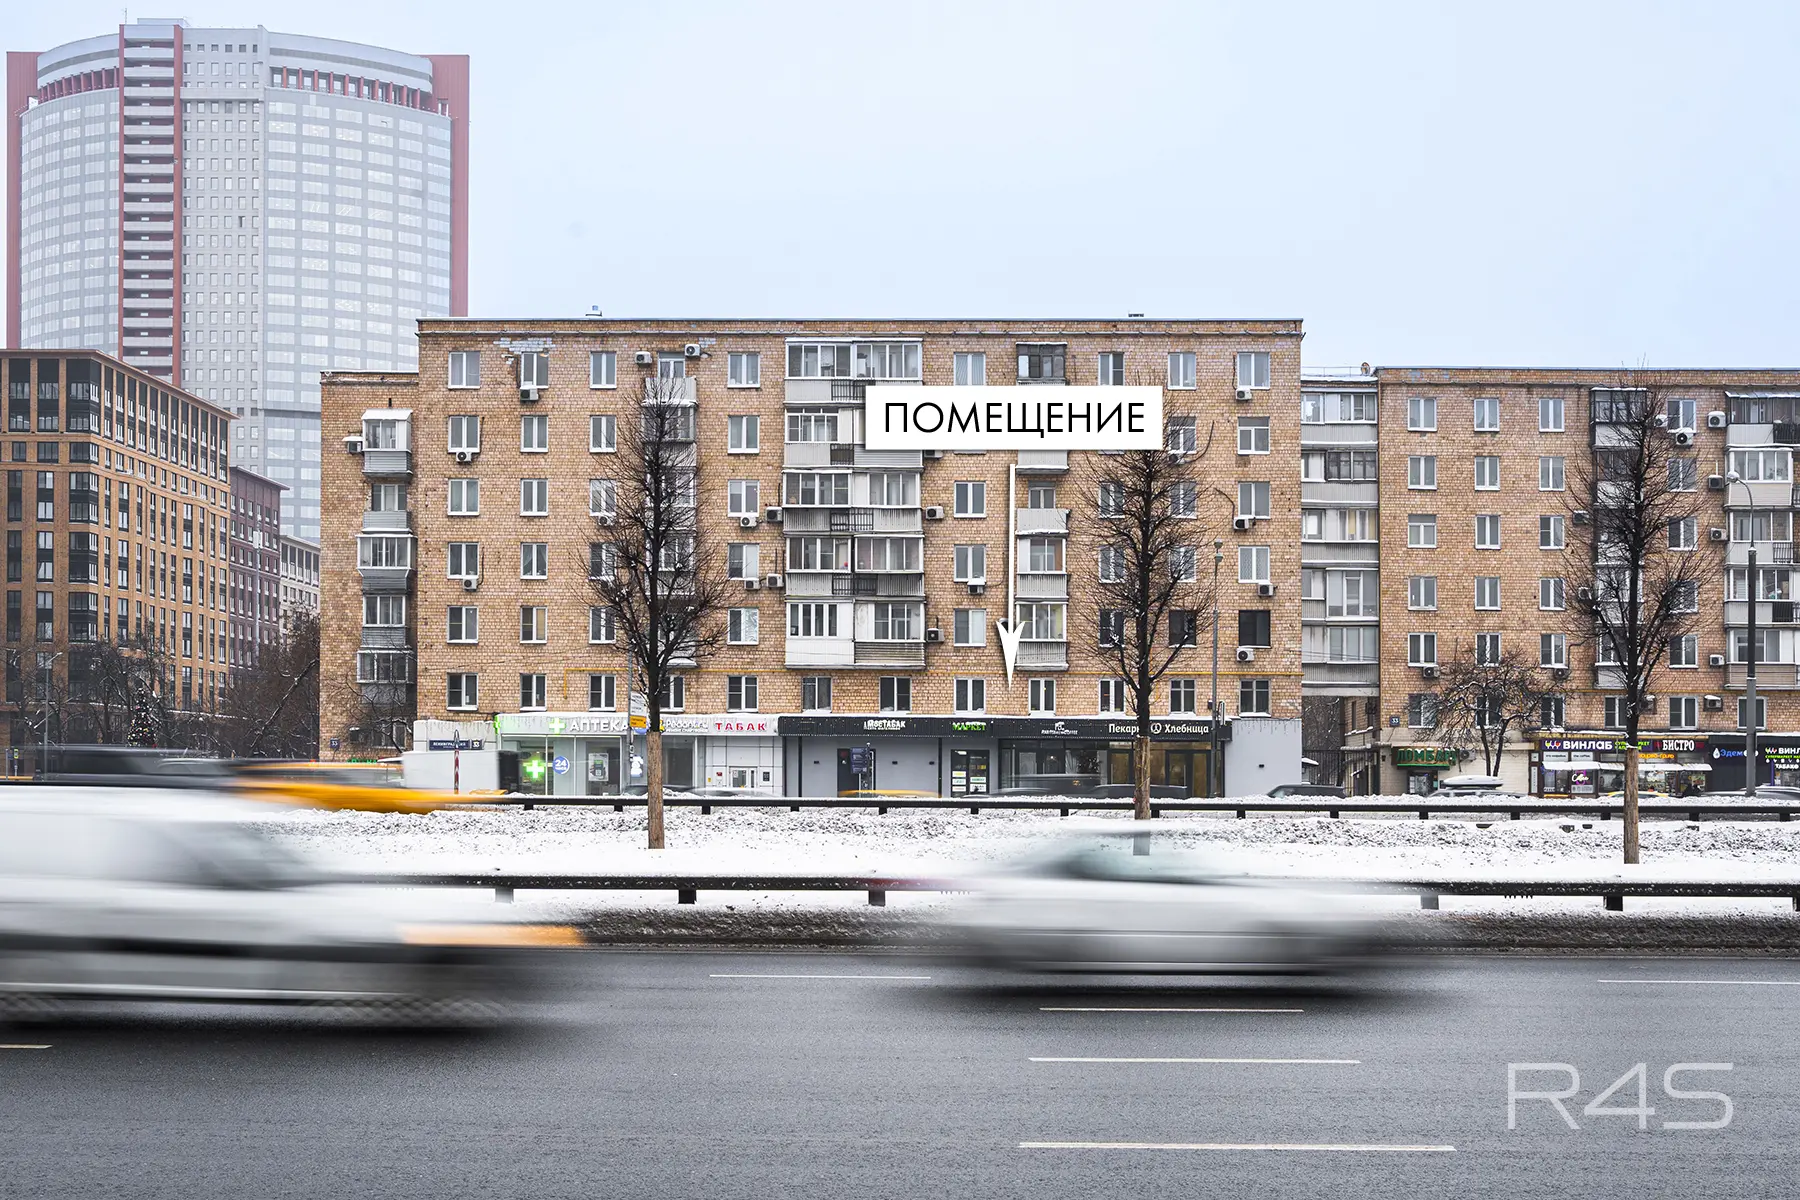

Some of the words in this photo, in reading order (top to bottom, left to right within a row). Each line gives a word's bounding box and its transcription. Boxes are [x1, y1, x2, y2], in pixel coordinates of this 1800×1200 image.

[570, 719, 629, 732] АПТЕКА
[715, 722, 767, 731] ТАБАК
[952, 721, 986, 731] МАРКЕТ
[1108, 723, 1140, 736] Пекарн
[1164, 723, 1209, 735] Хлебница
[1562, 740, 1613, 750] ВИНЛАБ
[1662, 740, 1695, 751] БИСТРО
[1720, 748, 1744, 757] Эдем
[555, 759, 572, 767] 24
